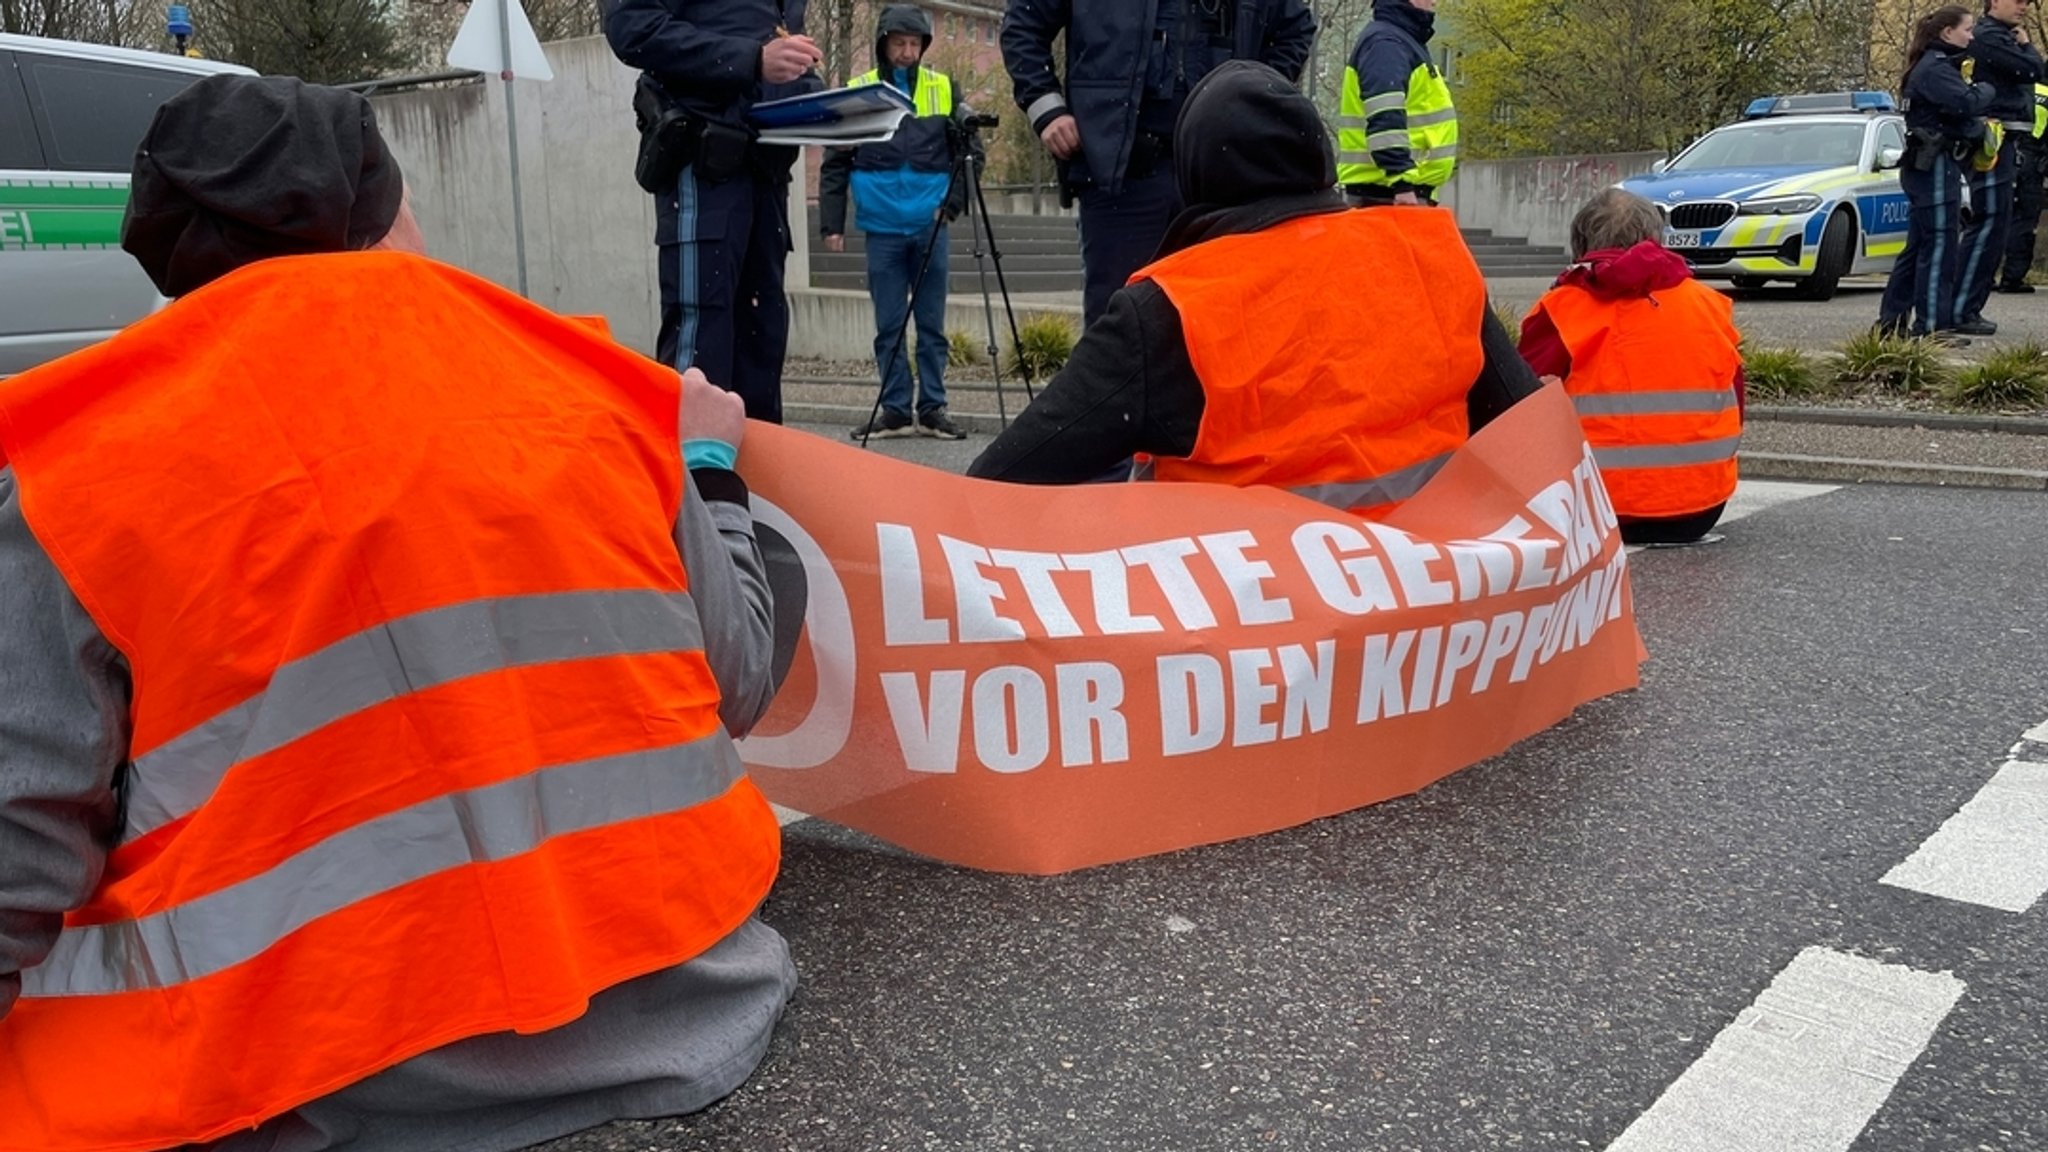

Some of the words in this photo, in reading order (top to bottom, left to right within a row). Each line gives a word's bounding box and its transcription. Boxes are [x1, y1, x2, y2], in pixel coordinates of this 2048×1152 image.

[1668, 233, 1698, 246] 8573
[876, 522, 1294, 646] LETZTE
[879, 661, 1129, 774] VOR
[1156, 638, 1336, 757] DEN
